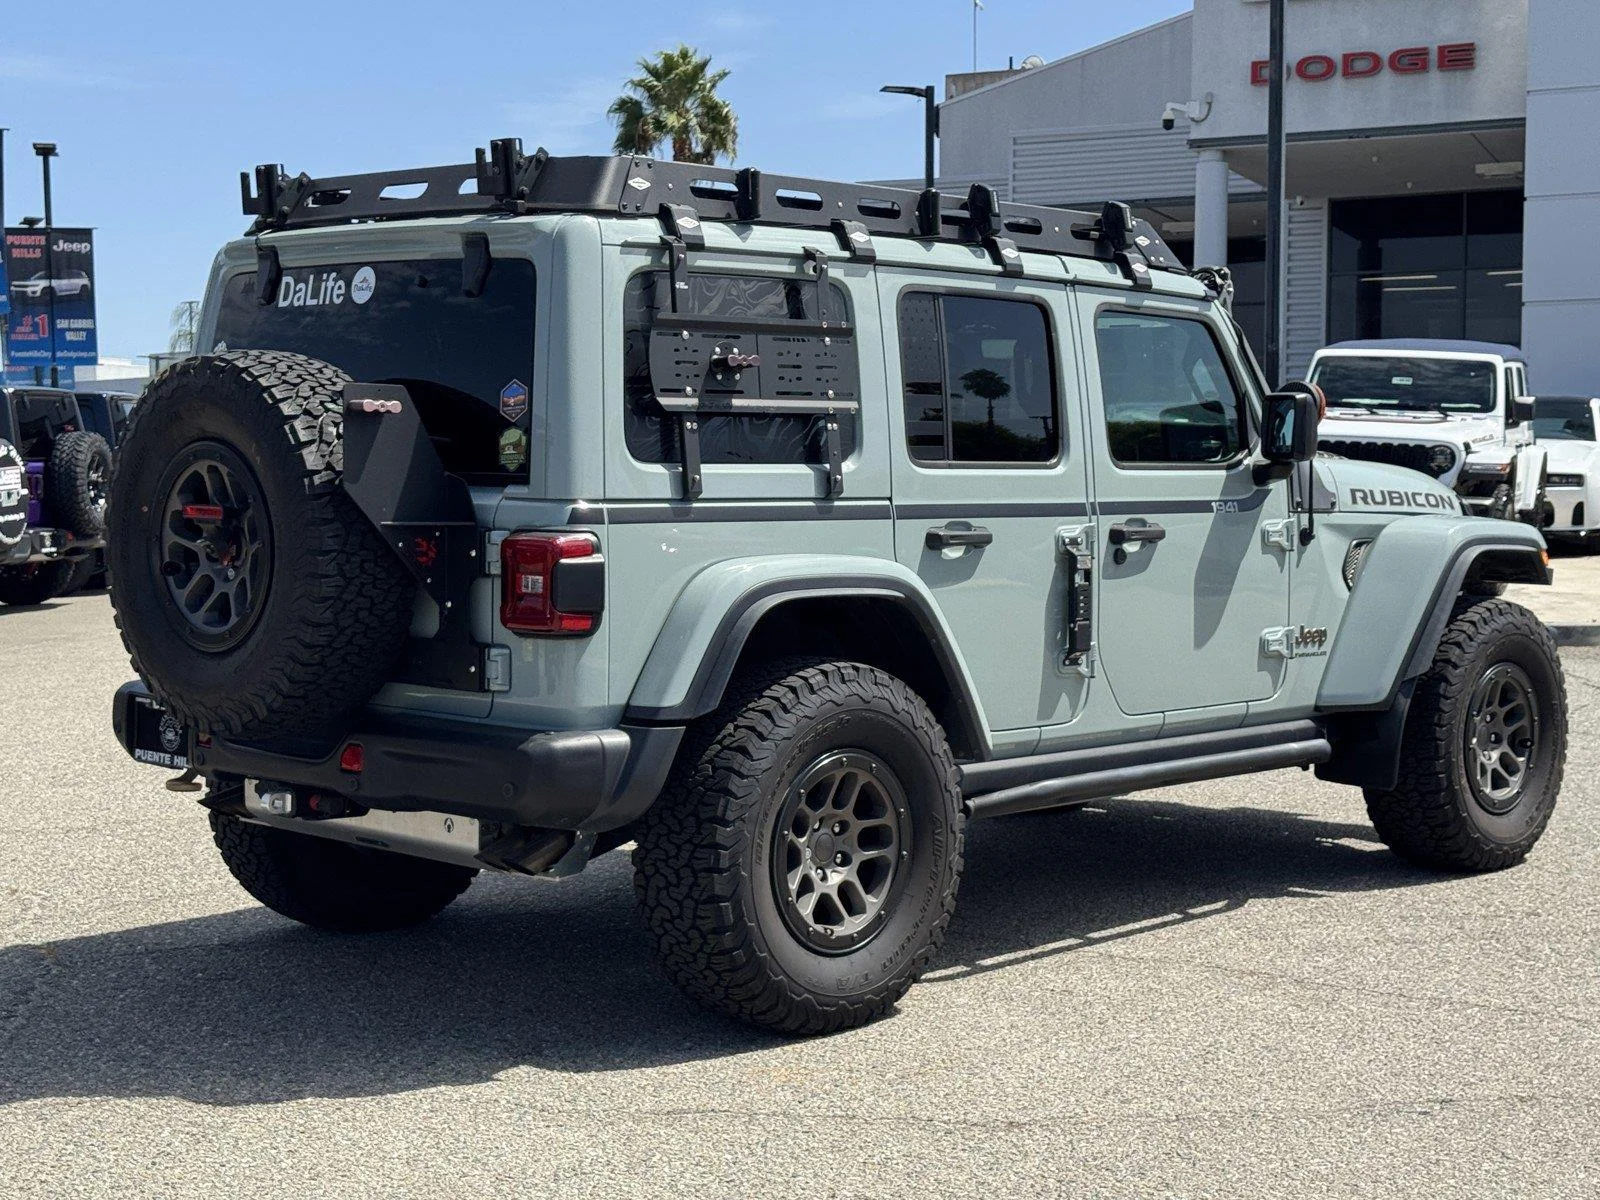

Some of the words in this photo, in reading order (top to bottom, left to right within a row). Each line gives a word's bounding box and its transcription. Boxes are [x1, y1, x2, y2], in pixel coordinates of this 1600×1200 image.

[1251, 42, 1476, 86] DODGE
[53, 239, 91, 254] Jeep
[278, 272, 346, 308] DaLife
[1211, 501, 1239, 514] 1941
[1349, 488, 1456, 510] RUBICON
[1294, 624, 1328, 650] Jeep
[135, 748, 172, 764] PUENTE
[173, 755, 190, 767] HIL
